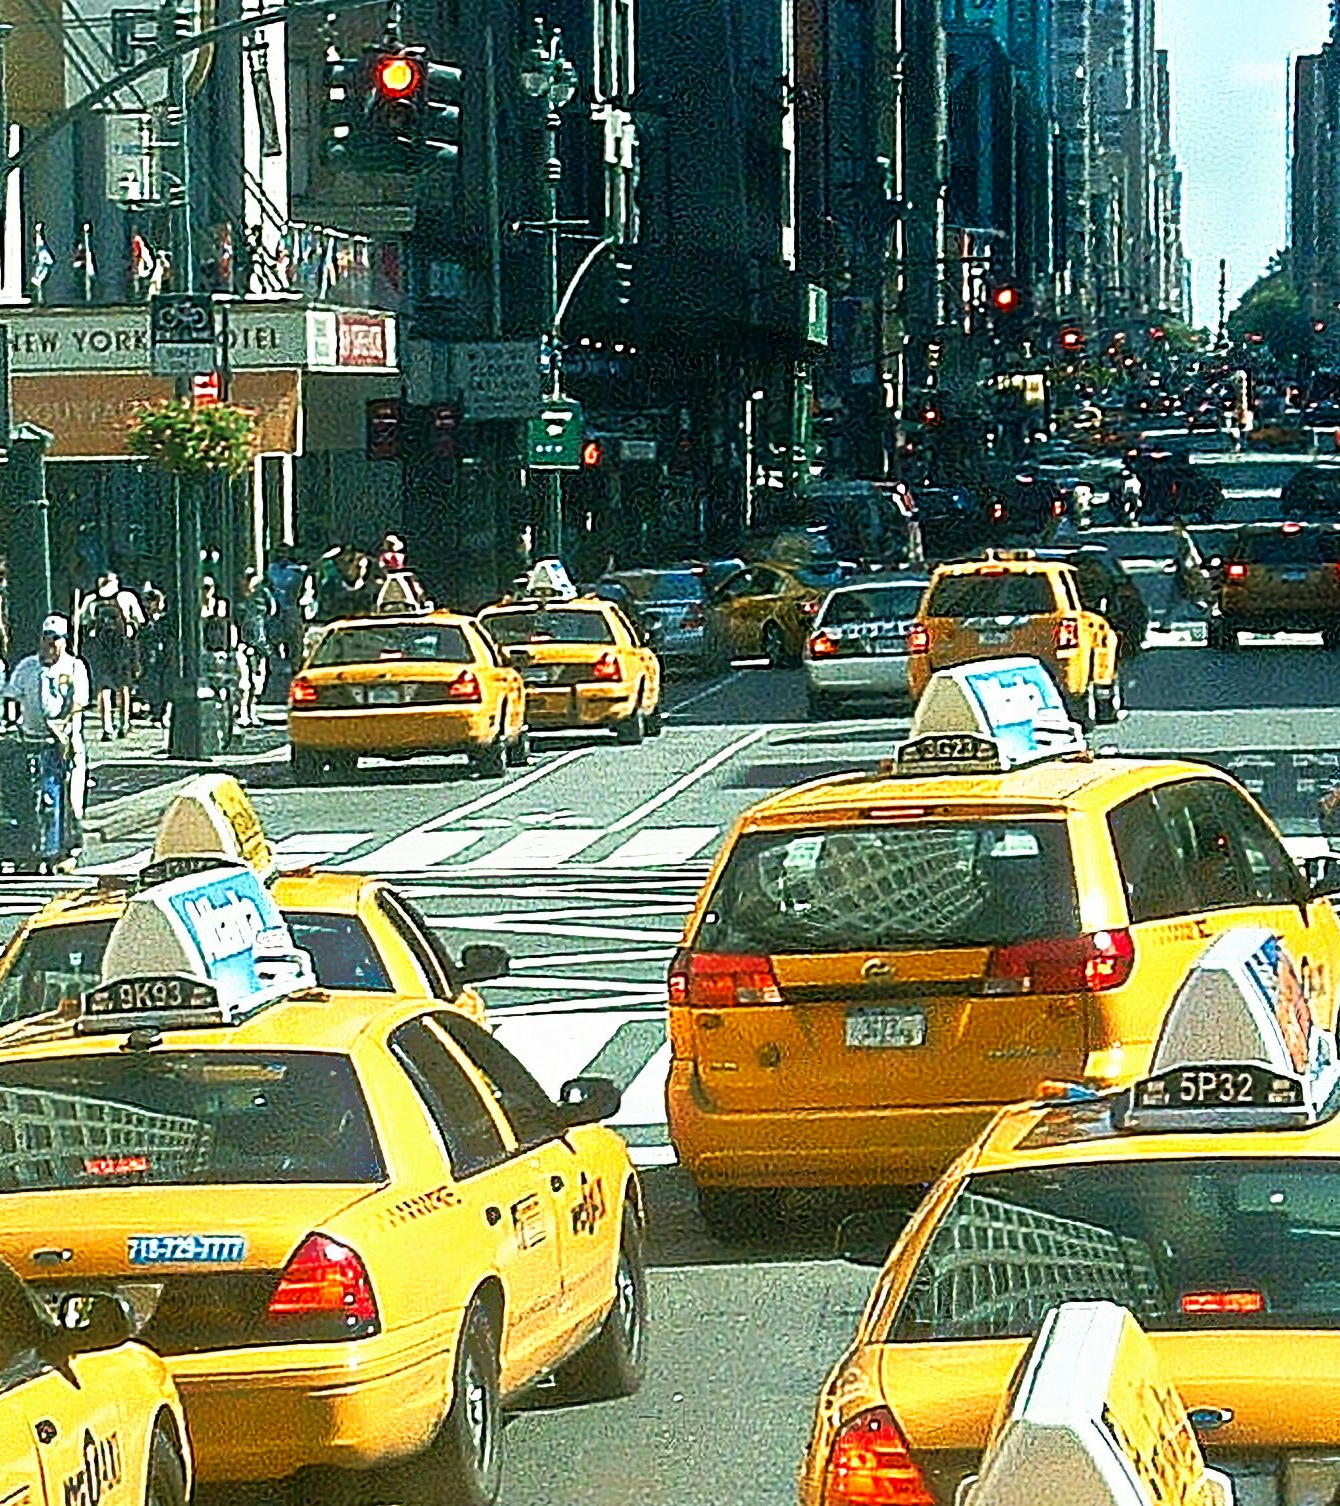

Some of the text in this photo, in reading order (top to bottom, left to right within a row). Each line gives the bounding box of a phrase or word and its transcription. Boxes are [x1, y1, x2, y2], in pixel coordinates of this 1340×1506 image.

[72, 329, 148, 353] YORK
[119, 980, 182, 1009] 9K93
[1180, 1071, 1253, 1102] 5P32
